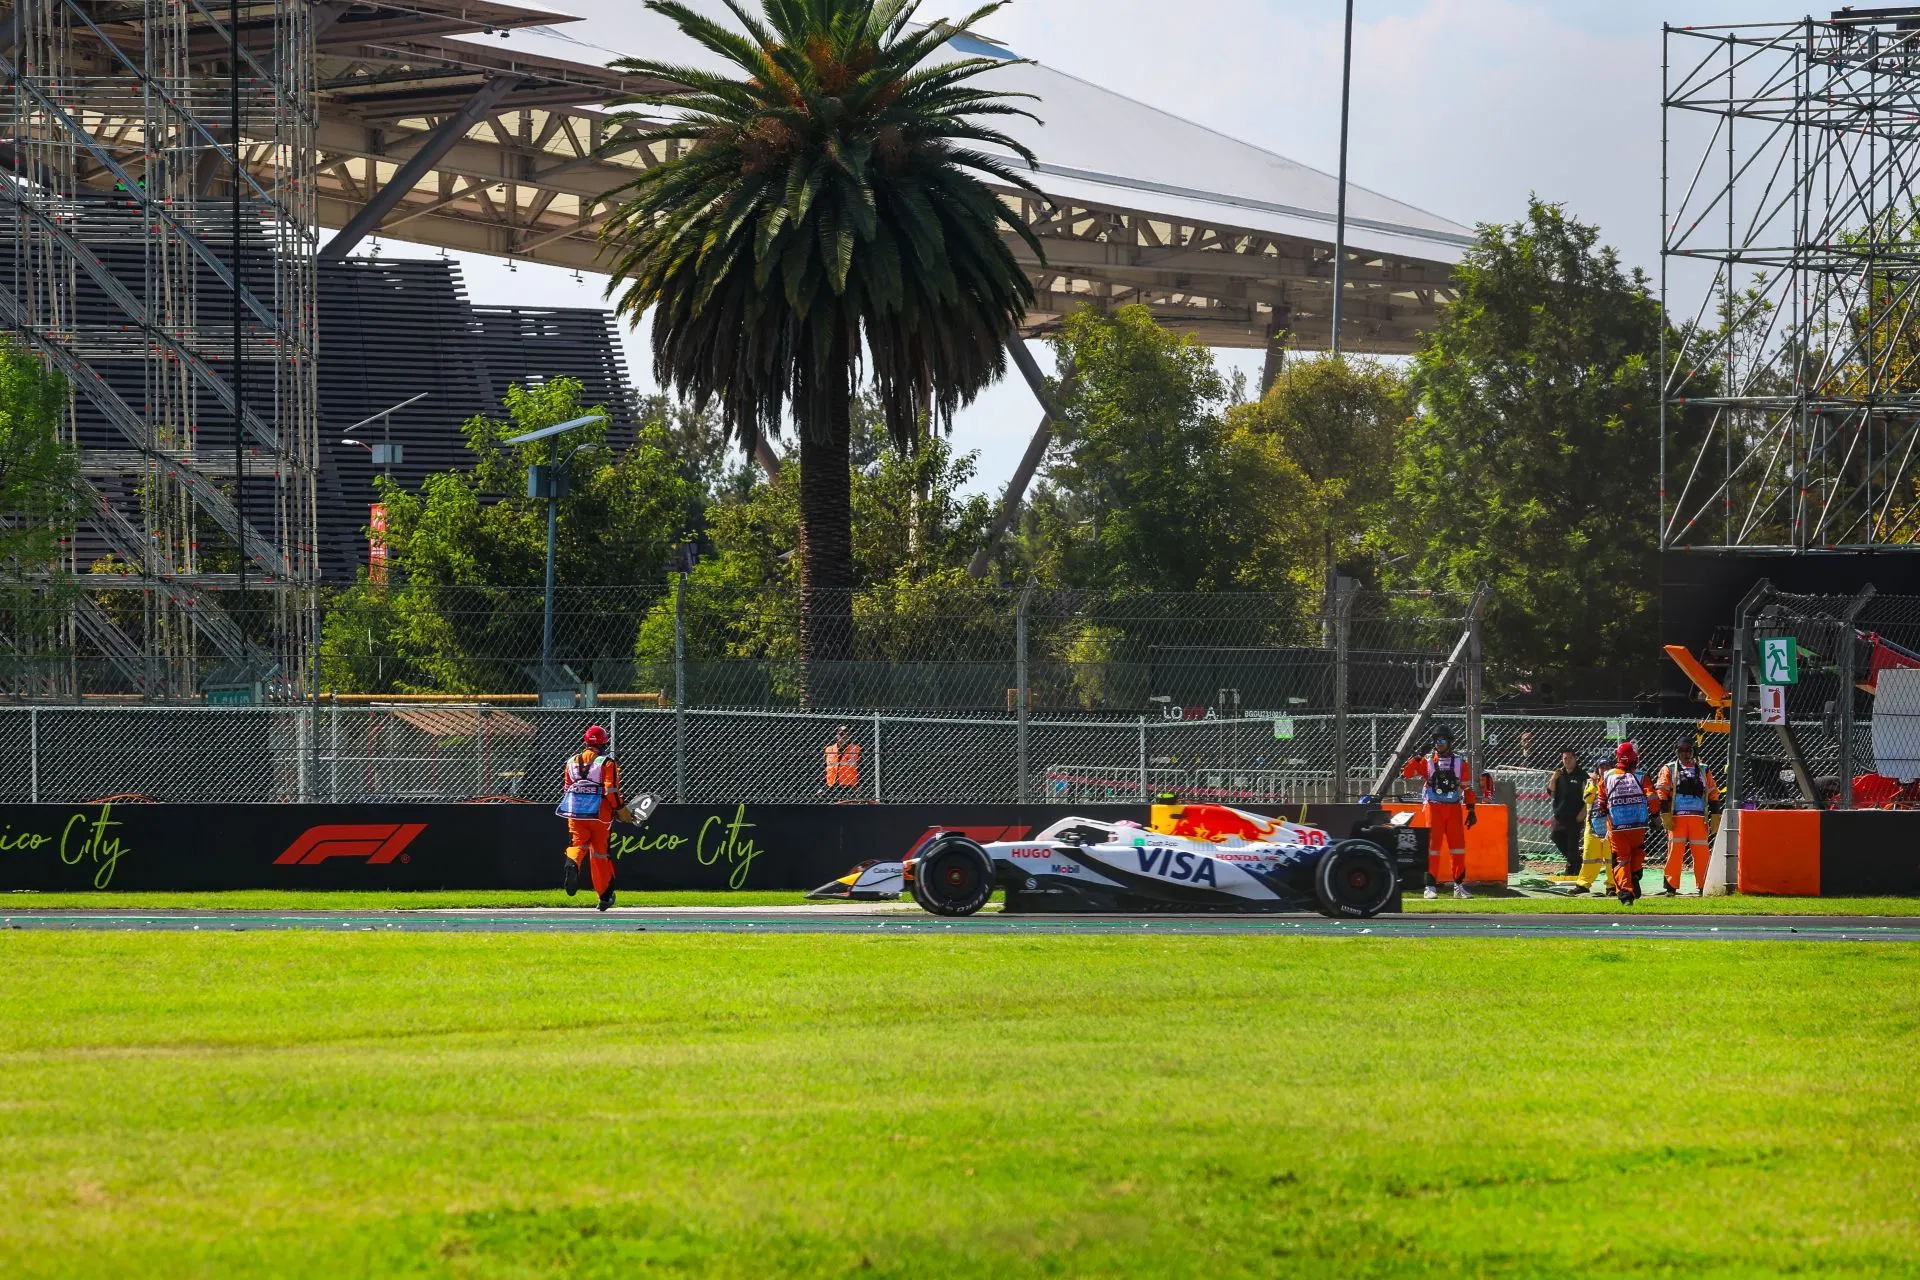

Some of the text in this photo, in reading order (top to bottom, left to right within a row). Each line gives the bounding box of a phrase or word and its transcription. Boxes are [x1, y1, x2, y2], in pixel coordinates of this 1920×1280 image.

[1611, 796, 1643, 806] COURSE
[60, 803, 131, 889] City
[272, 823, 429, 865] F1
[696, 803, 765, 890] City
[1011, 848, 1052, 859] HUGO
[1051, 864, 1080, 874] Mobil
[1131, 846, 1218, 888] VISA
[1215, 853, 1260, 862] HONDA
